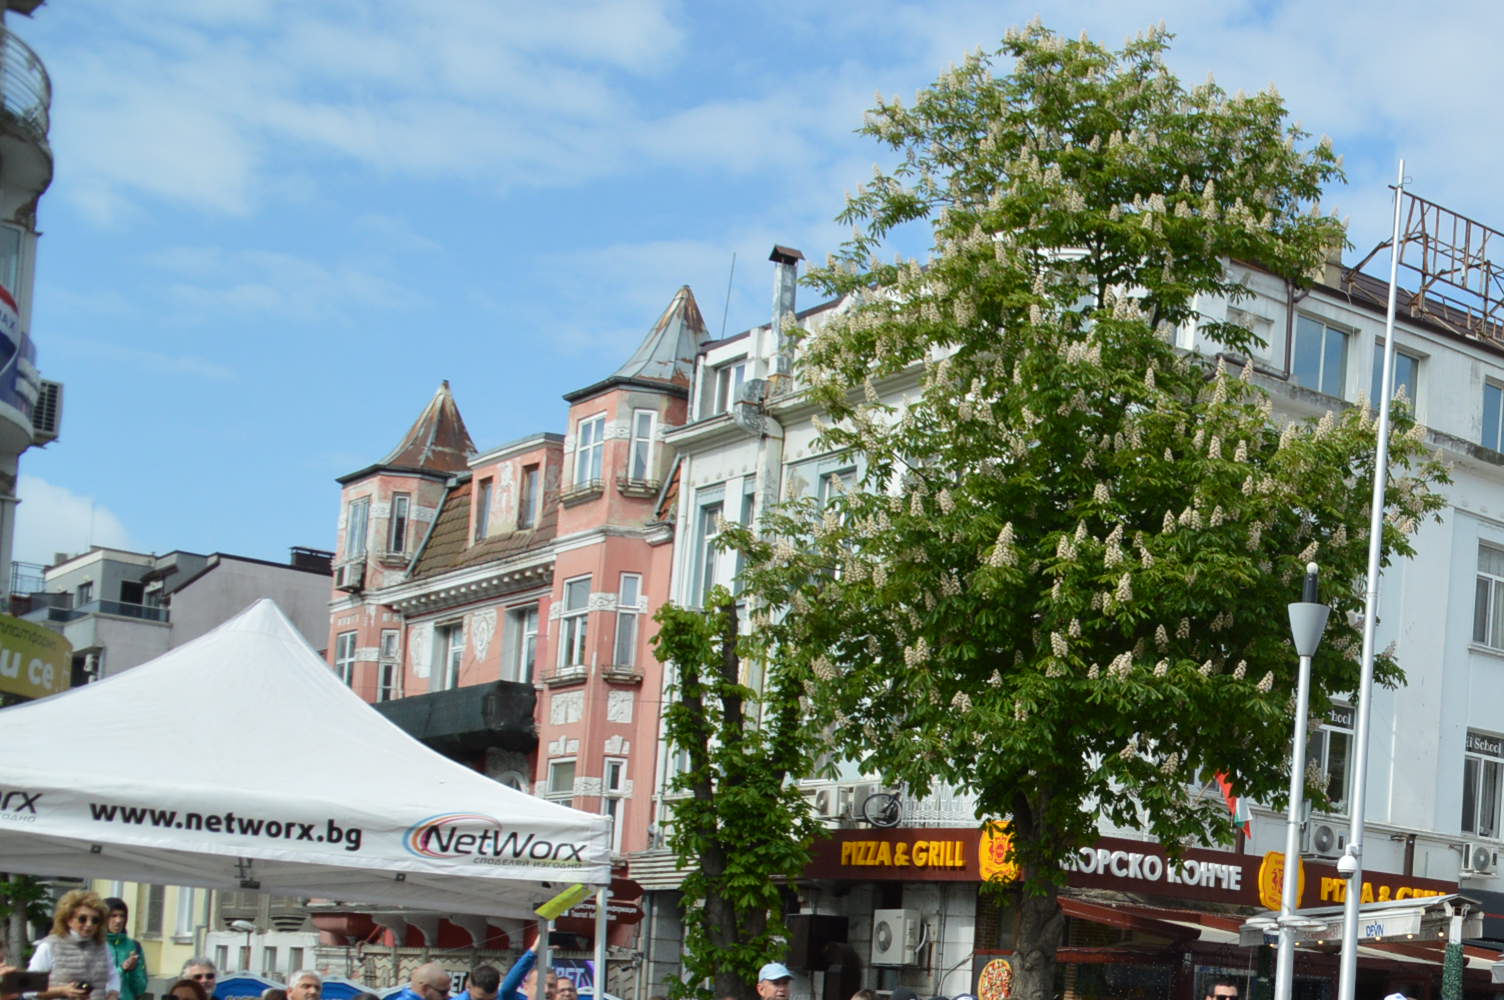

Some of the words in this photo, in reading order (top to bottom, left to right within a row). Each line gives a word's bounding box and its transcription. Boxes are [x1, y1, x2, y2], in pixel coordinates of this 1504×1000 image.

[1328, 710, 1352, 726] hool
[1474, 736, 1502, 756] School
[90, 802, 363, 851] www.networx.bg
[424, 825, 588, 863] NetWorx
[841, 841, 892, 867] PIZZA
[894, 841, 911, 867] &
[912, 840, 966, 868] GRILL
